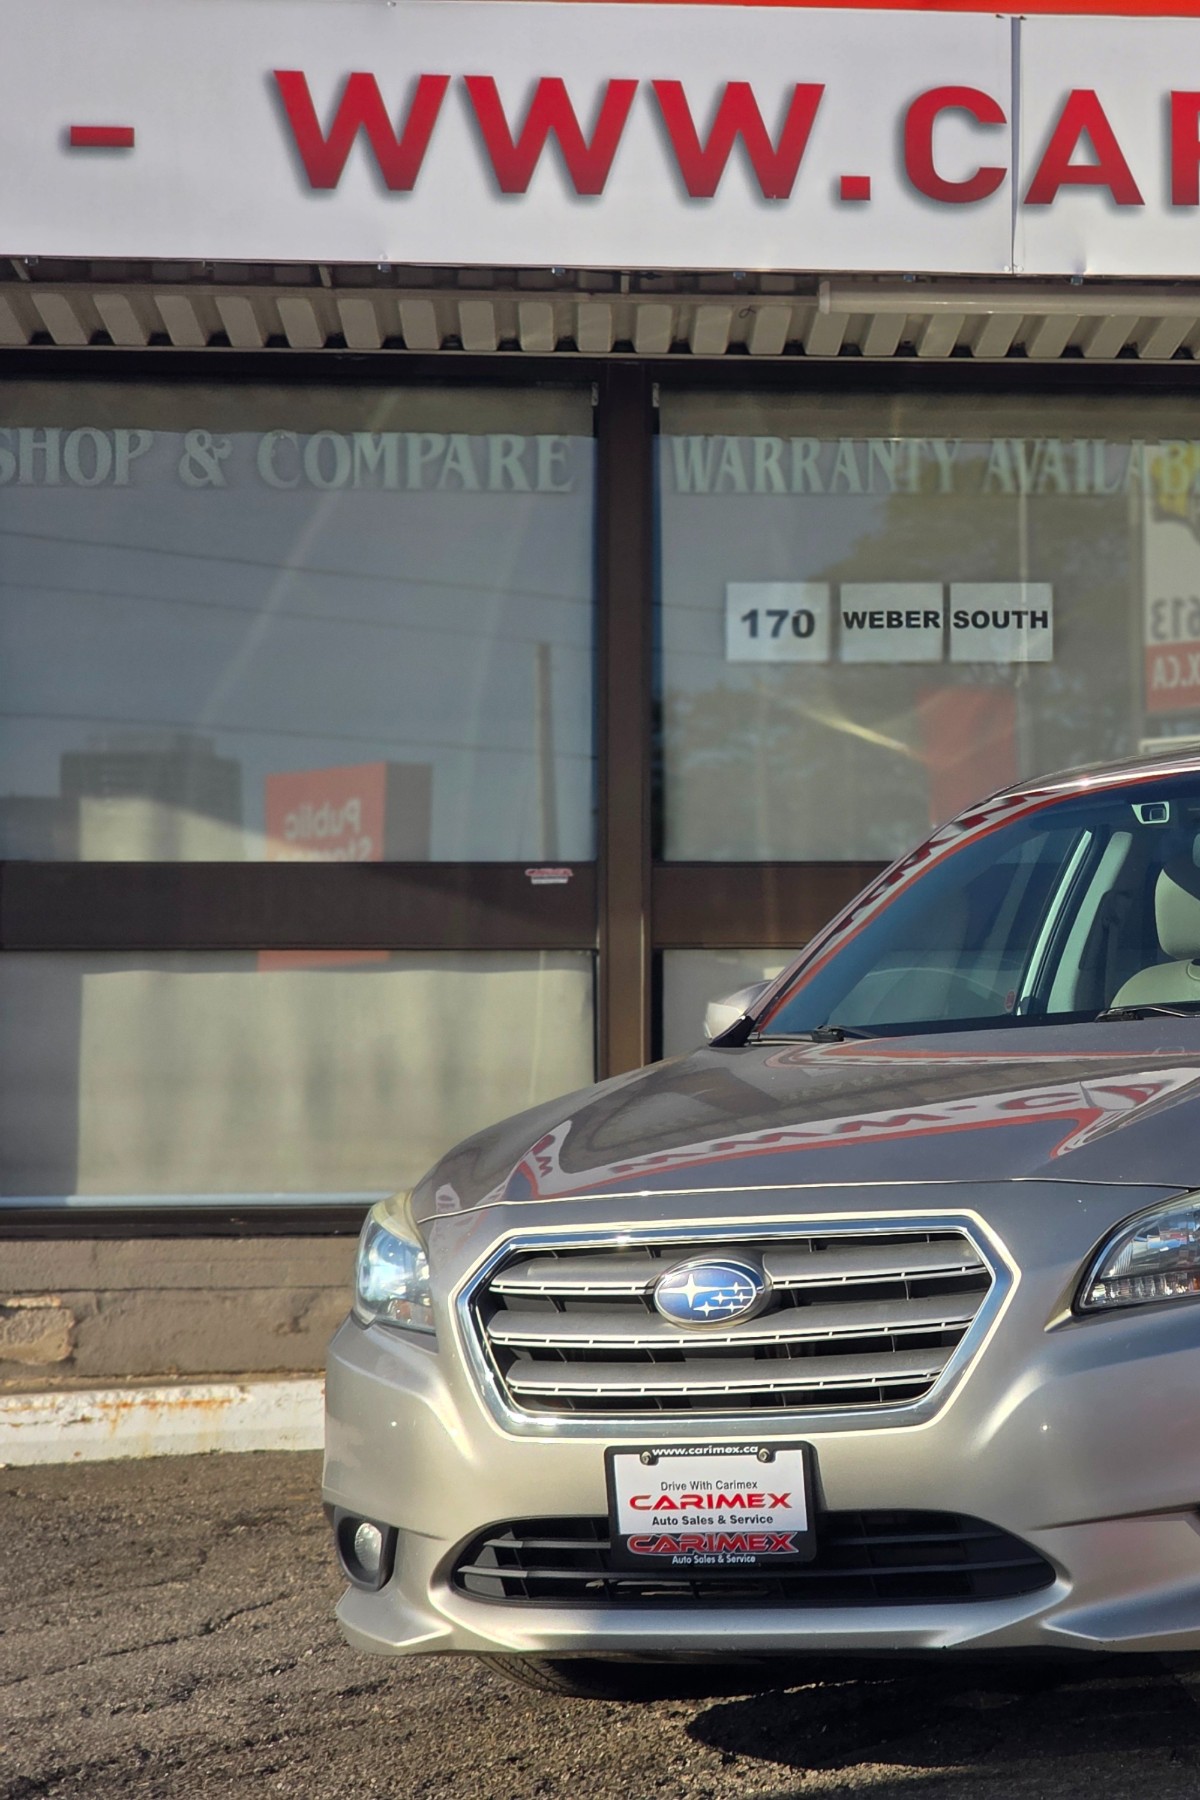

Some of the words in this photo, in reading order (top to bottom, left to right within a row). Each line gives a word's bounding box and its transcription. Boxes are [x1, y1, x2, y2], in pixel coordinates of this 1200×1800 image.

[178, 429, 232, 488] &
[256, 430, 576, 493] COMPARE
[671, 436, 963, 494] WARRANTY
[741, 608, 817, 640] 170
[843, 609, 941, 630] WEBER
[952, 609, 1049, 630] SOUTH
[652, 1444, 759, 1458] www.carimex.ca
[660, 1480, 688, 1492] Drive
[689, 1479, 713, 1491] With
[715, 1478, 758, 1491] Carimex
[629, 1492, 792, 1511] CARIMEX
[651, 1515, 679, 1527] Auto
[682, 1515, 716, 1526] Sales
[717, 1514, 726, 1525] &
[729, 1513, 774, 1525] Service
[627, 1531, 800, 1556] CARIMEX
[672, 1554, 692, 1565] Auto
[693, 1554, 717, 1565] Sales
[717, 1554, 725, 1564] &
[726, 1554, 756, 1564] Service
